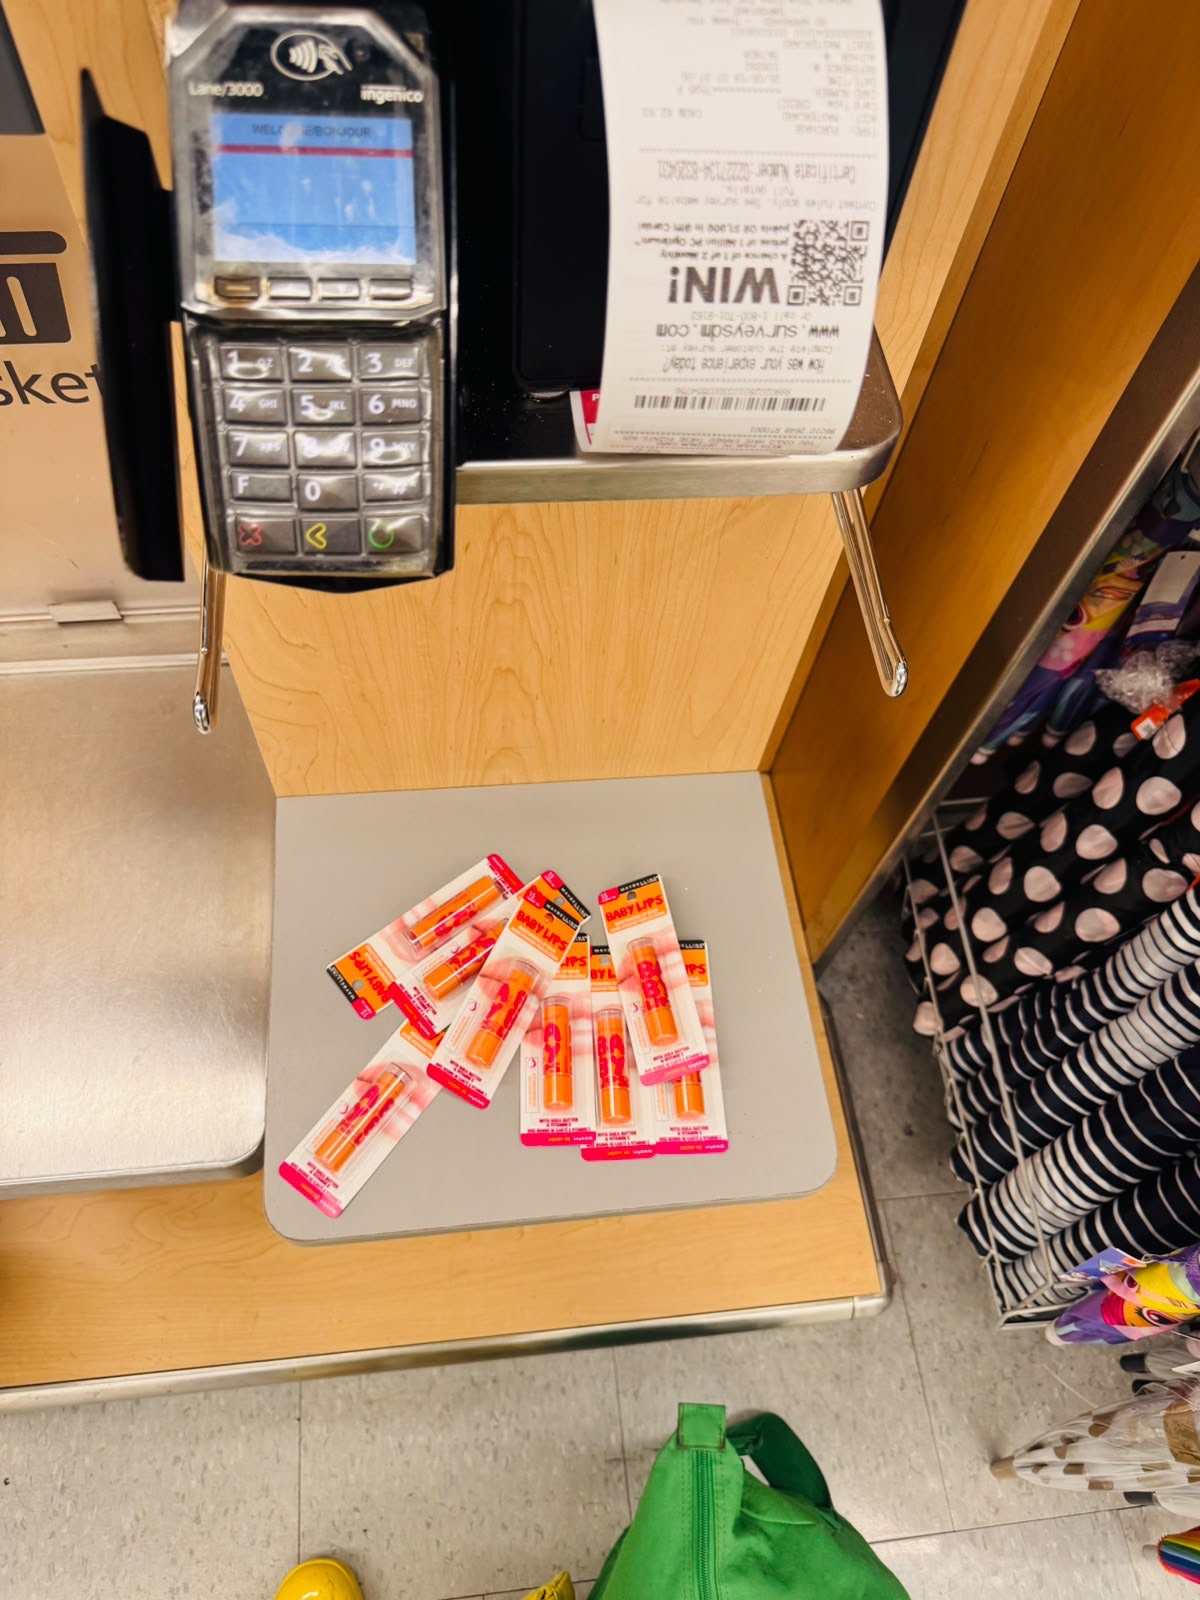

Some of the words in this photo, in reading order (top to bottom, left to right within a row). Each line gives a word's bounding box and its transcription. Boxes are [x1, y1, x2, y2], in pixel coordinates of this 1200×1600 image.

[188, 81, 264, 98] Lane/3000
[360, 83, 425, 105] ingenico
[794, 165, 857, 185] Certificate
[731, 252, 742, 261] of
[744, 252, 779, 261] chance
[780, 252, 788, 260] A
[667, 266, 781, 305] WIN!
[655, 322, 840, 343] www.surveysdm.com
[297, 352, 313, 373] 2
[366, 352, 383, 374] 3
[394, 357, 415, 368] DEF
[662, 355, 697, 373] today?
[701, 355, 757, 373] experience
[763, 355, 784, 371] your
[786, 357, 805, 371] was
[806, 357, 825, 374] How
[229, 392, 246, 413] 4
[258, 399, 278, 409] GHI
[300, 395, 315, 416] 5
[368, 394, 385, 415] 6
[391, 399, 418, 409] MNO
[233, 436, 249, 457] 7
[302, 437, 319, 459] 8
[369, 437, 386, 459] 9
[237, 476, 249, 495] F
[304, 480, 321, 501] 0
[605, 903, 635, 922] BABY
[635, 894, 664, 911] LIPS
[515, 909, 545, 934] BABY
[542, 928, 569, 952] LIPS
[347, 948, 374, 978] LIPS
